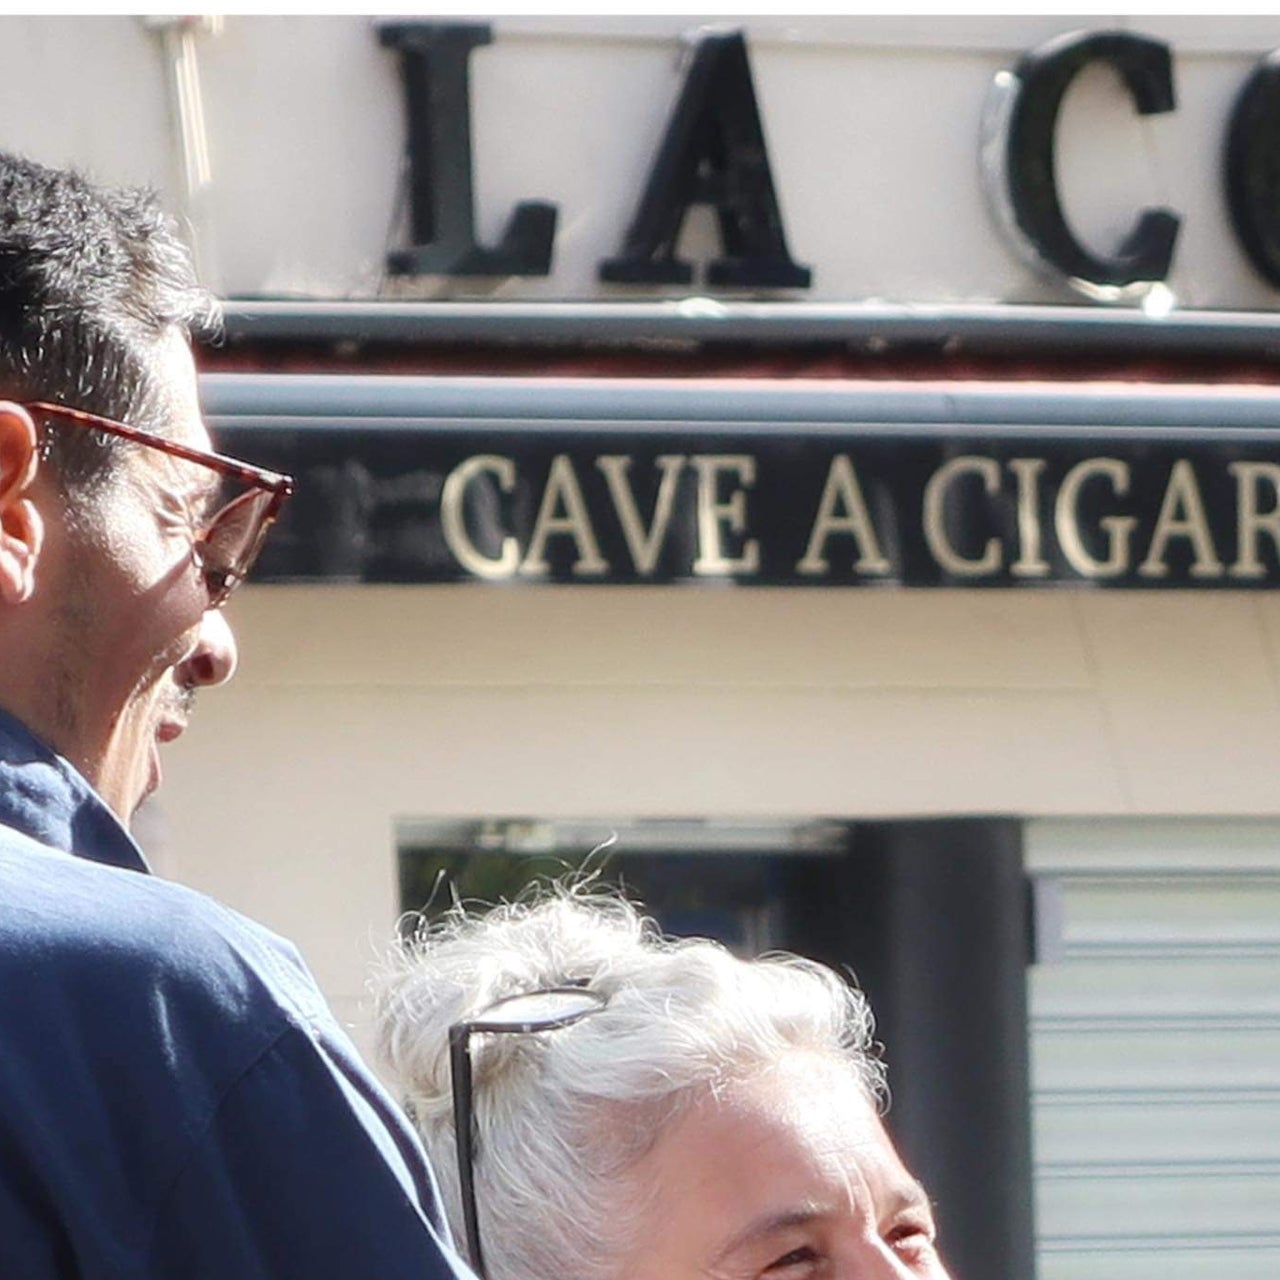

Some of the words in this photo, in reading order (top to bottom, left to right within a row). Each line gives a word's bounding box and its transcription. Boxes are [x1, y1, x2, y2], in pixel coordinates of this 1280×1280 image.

[376, 22, 813, 289] LA
[442, 454, 759, 579] CAVE
[796, 454, 893, 577] A
